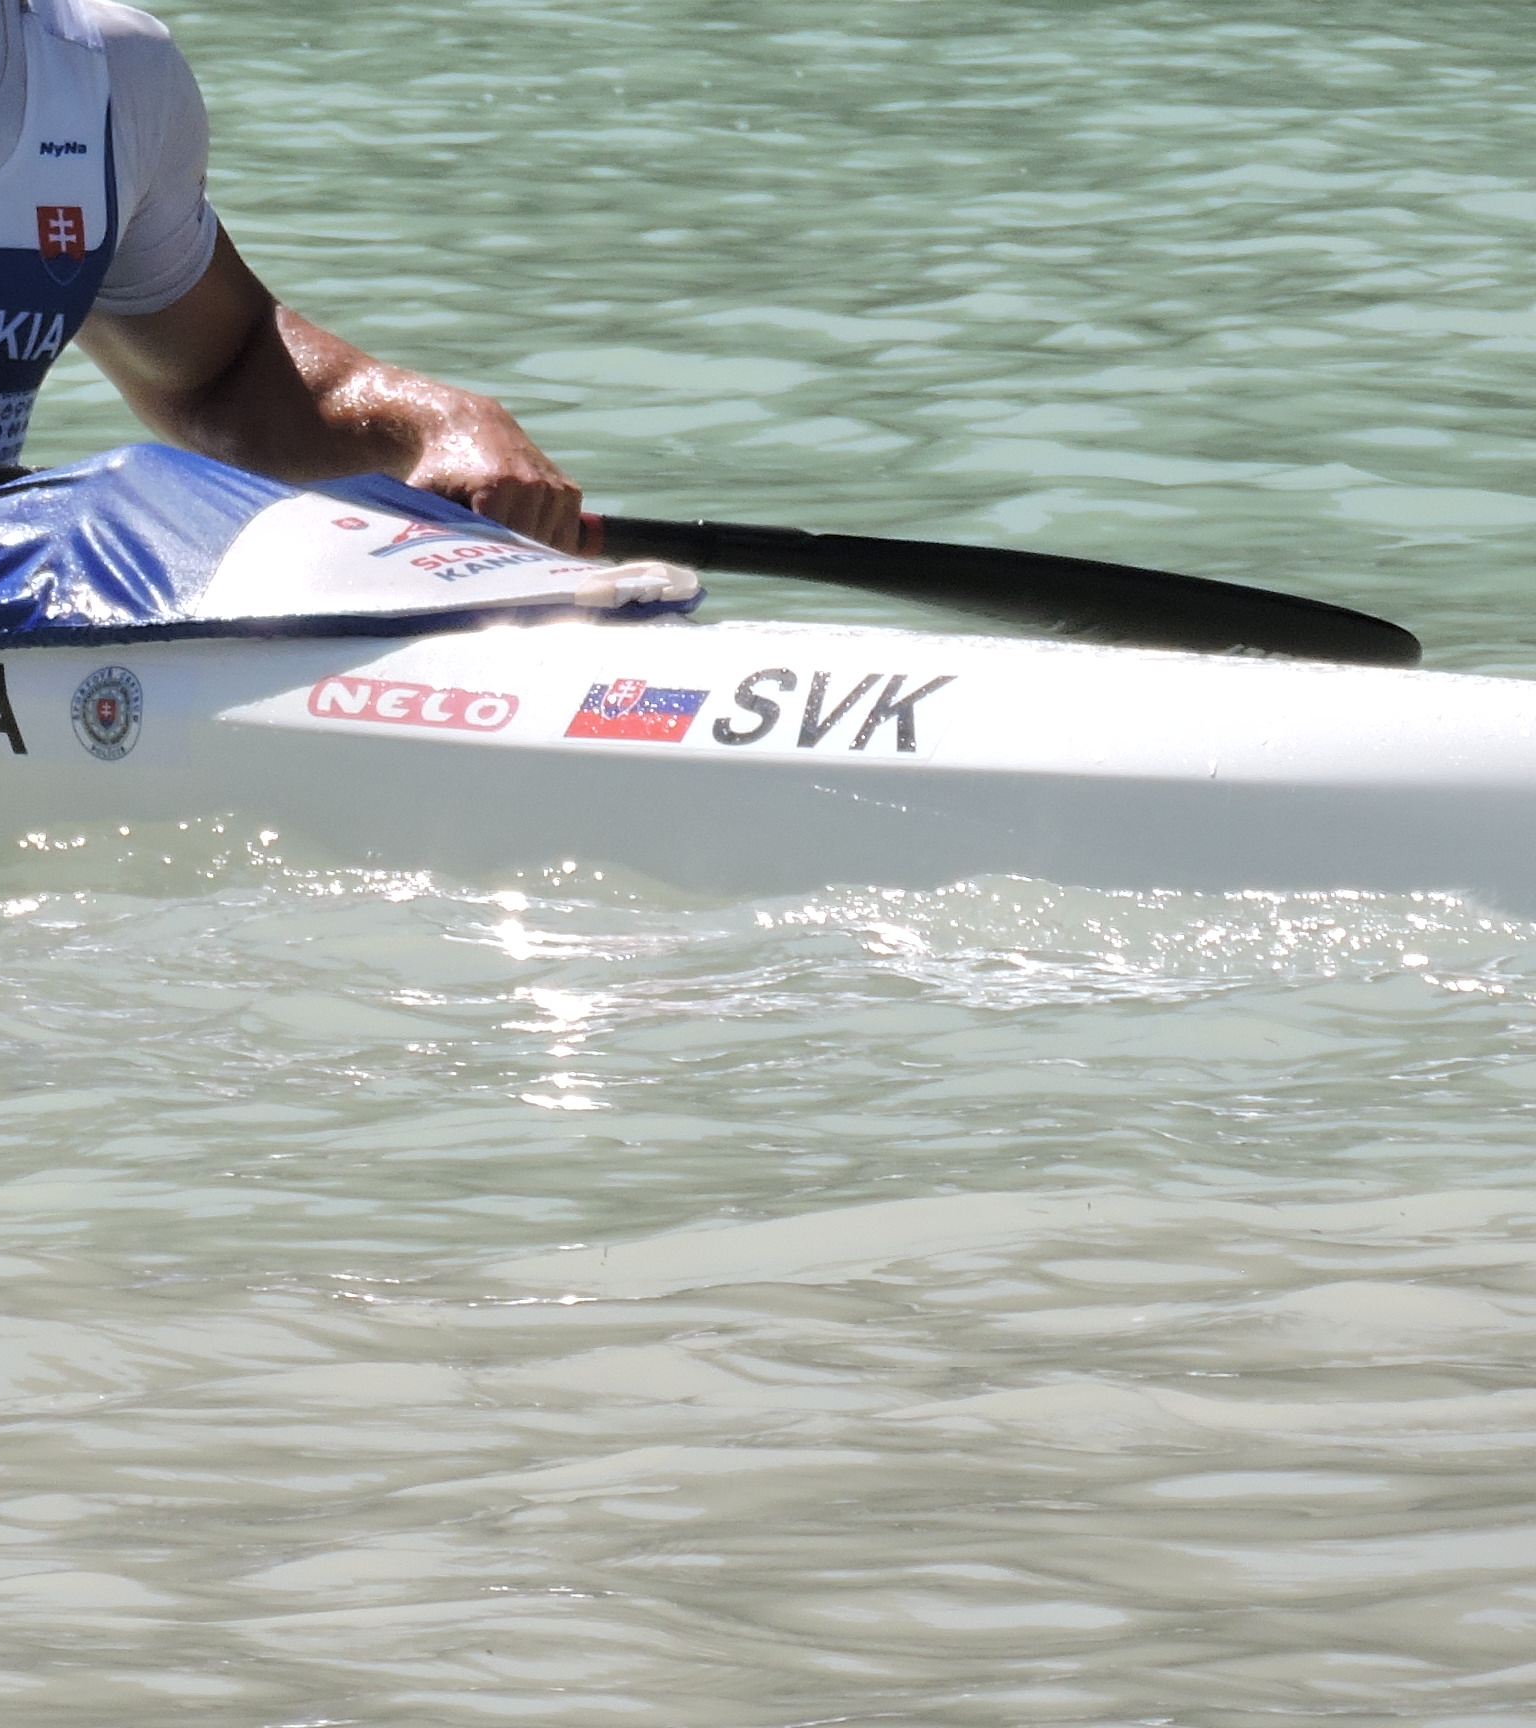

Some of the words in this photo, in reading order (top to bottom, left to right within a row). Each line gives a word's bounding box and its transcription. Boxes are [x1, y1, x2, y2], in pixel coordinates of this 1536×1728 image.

[39, 141, 87, 157] NyNa
[316, 681, 510, 726] NELO
[712, 667, 958, 752] SVK
